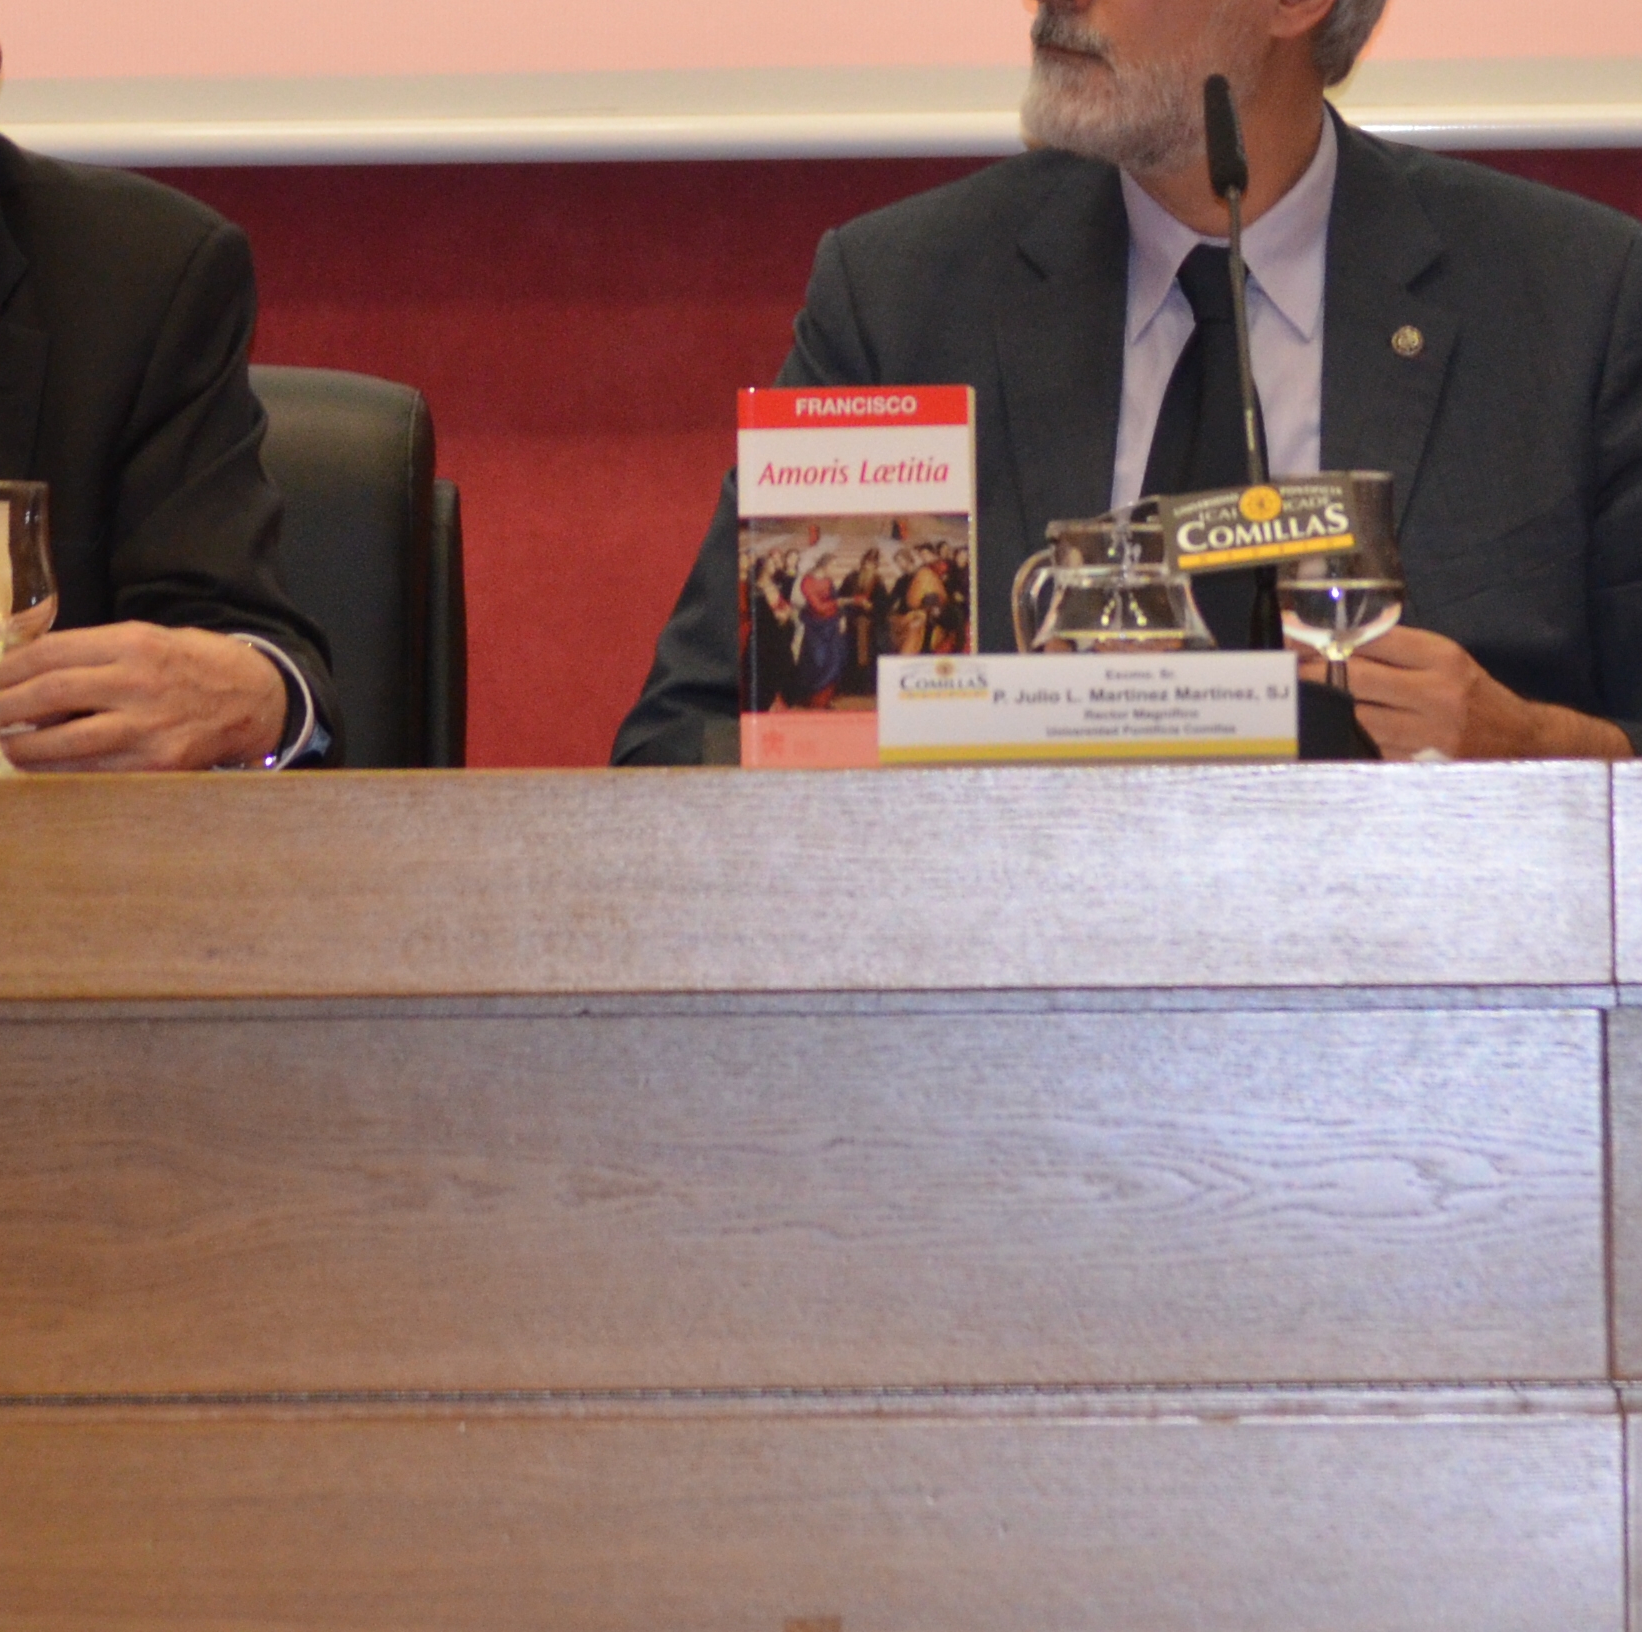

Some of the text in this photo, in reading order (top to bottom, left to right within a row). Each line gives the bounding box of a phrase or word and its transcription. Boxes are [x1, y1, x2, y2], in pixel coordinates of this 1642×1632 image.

[795, 395, 918, 416] FRANCISCO
[757, 456, 950, 487] Amoris Lætitia
[1177, 503, 1349, 552] COMILLAS
[1014, 688, 1060, 704] Julio
[1066, 689, 1081, 704] L.
[1266, 685, 1290, 701] SJ
